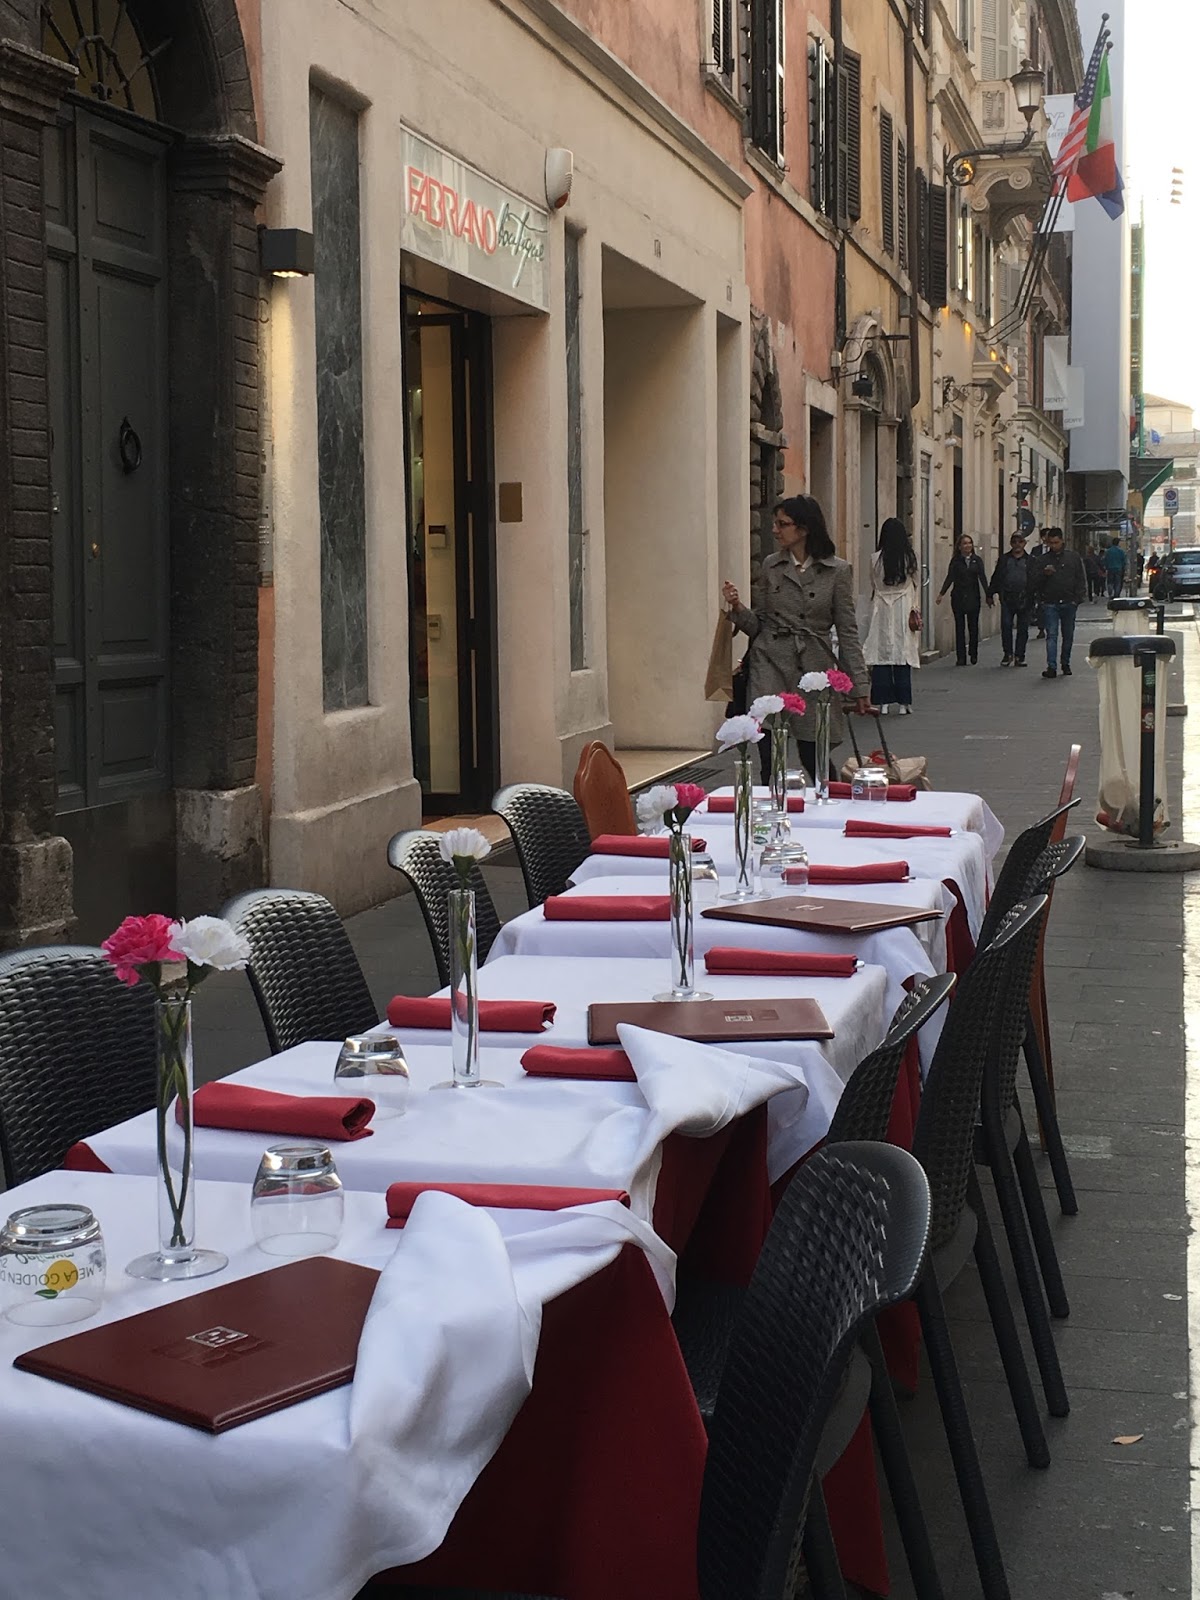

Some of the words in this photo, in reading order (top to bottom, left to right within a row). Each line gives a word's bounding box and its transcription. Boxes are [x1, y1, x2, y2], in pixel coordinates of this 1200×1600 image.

[404, 165, 497, 255] FABRIANO
[8, 1273, 59, 1285] GOLDEN
[64, 1267, 93, 1281] MELA
